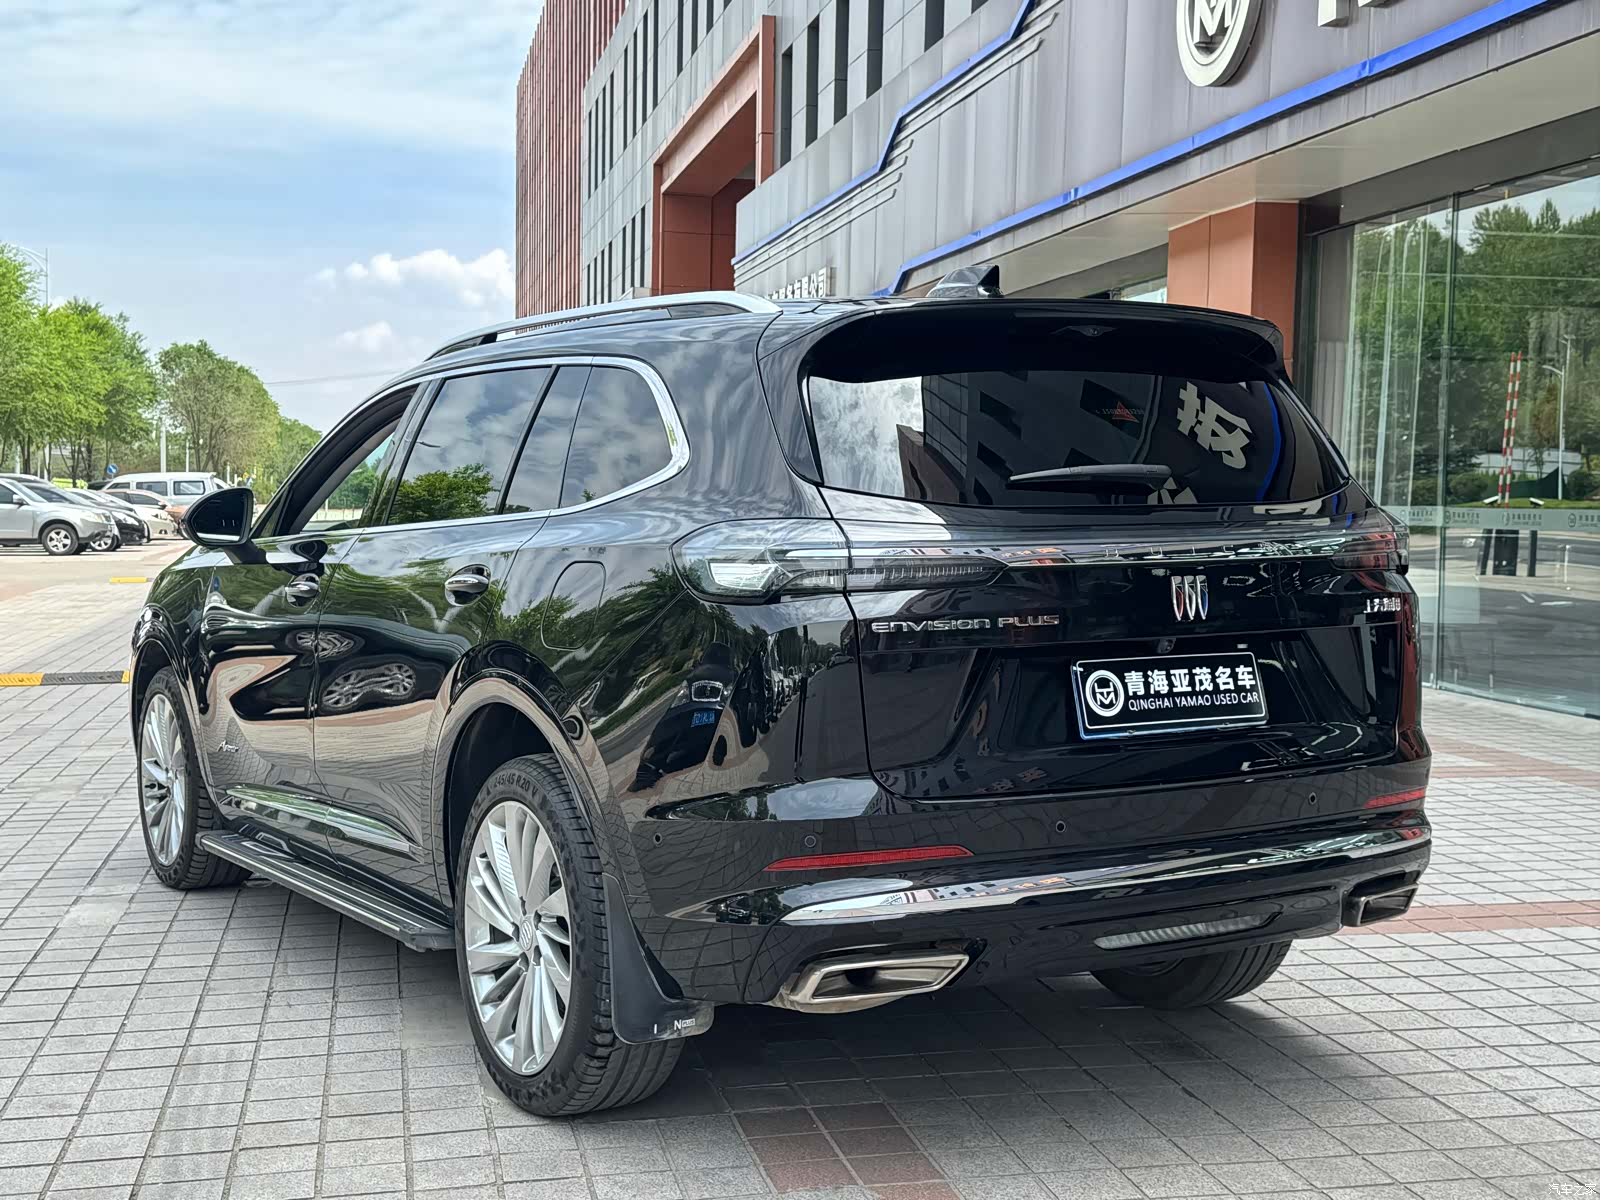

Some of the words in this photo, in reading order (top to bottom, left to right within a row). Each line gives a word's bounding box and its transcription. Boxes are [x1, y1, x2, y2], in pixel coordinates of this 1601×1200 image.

[871, 618, 990, 633] ENVISION
[998, 614, 1060, 628] PLUS
[1123, 665, 1256, 696] 青海亚茂名车
[1128, 697, 1174, 711] QINGHAI
[1174, 694, 1212, 707] YAMAO
[1213, 692, 1239, 705] USED
[1241, 691, 1260, 703] CAR
